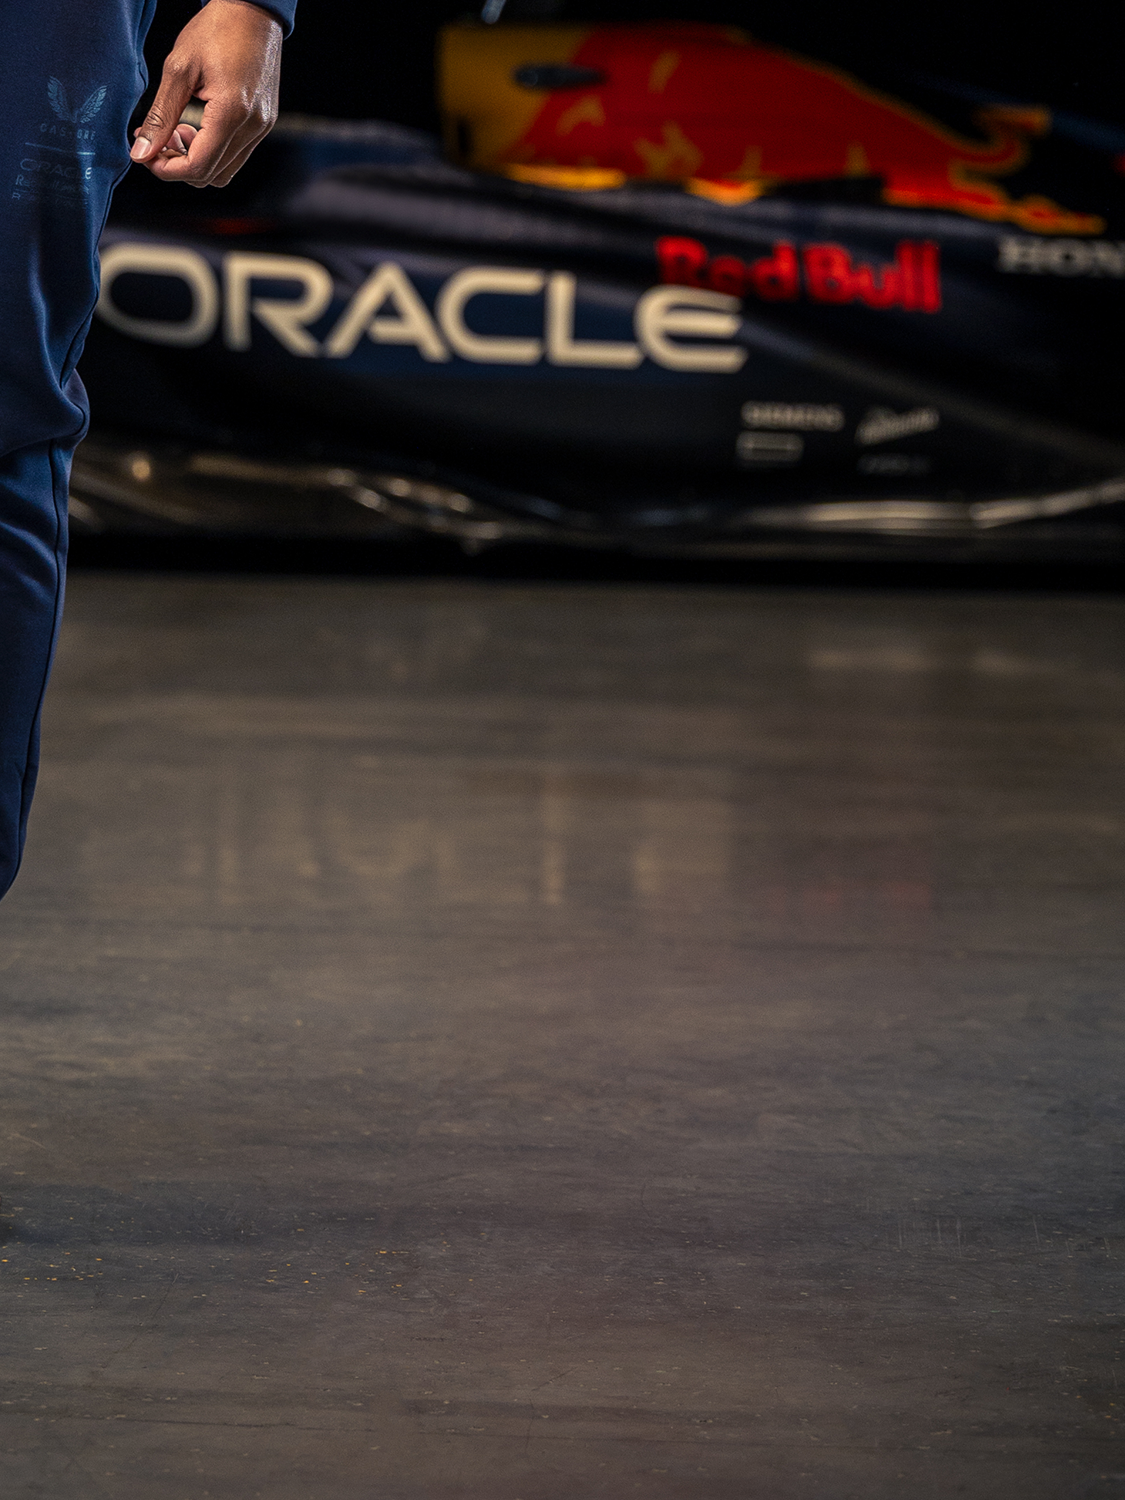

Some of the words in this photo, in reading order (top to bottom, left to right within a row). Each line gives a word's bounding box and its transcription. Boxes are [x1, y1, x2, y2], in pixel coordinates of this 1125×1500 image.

[39, 122, 96, 141] CASORE
[801, 241, 942, 314] Bull
[995, 237, 1125, 278] HON
[96, 241, 749, 374] ORACLE
